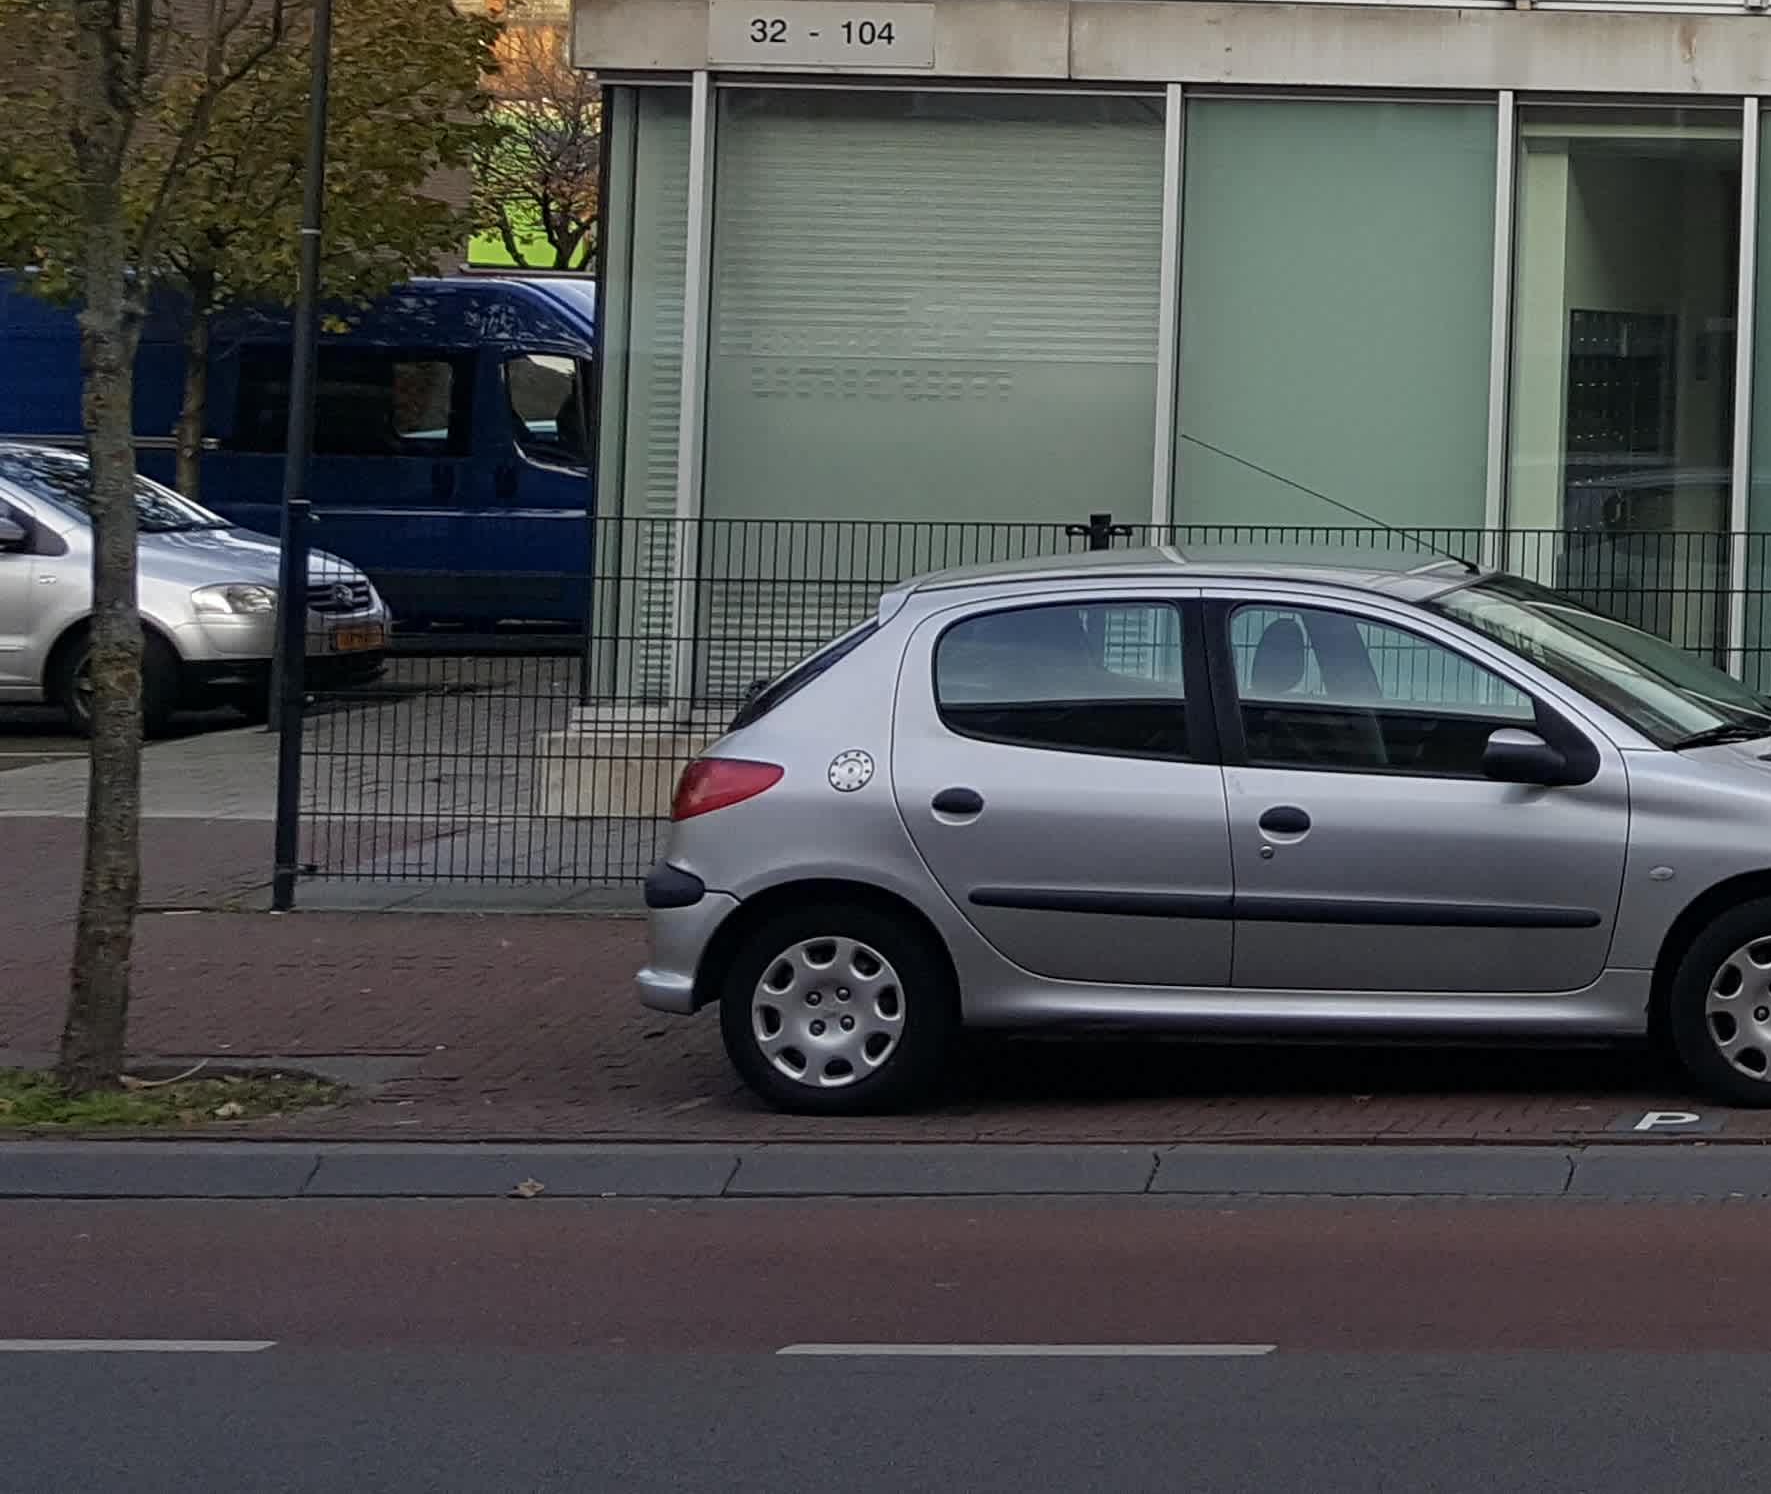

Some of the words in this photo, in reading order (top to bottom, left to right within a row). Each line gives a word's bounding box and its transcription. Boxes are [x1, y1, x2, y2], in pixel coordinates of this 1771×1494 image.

[750, 19, 787, 43] 32
[841, 21, 895, 45] 104
[1633, 1112, 1700, 1130] P
